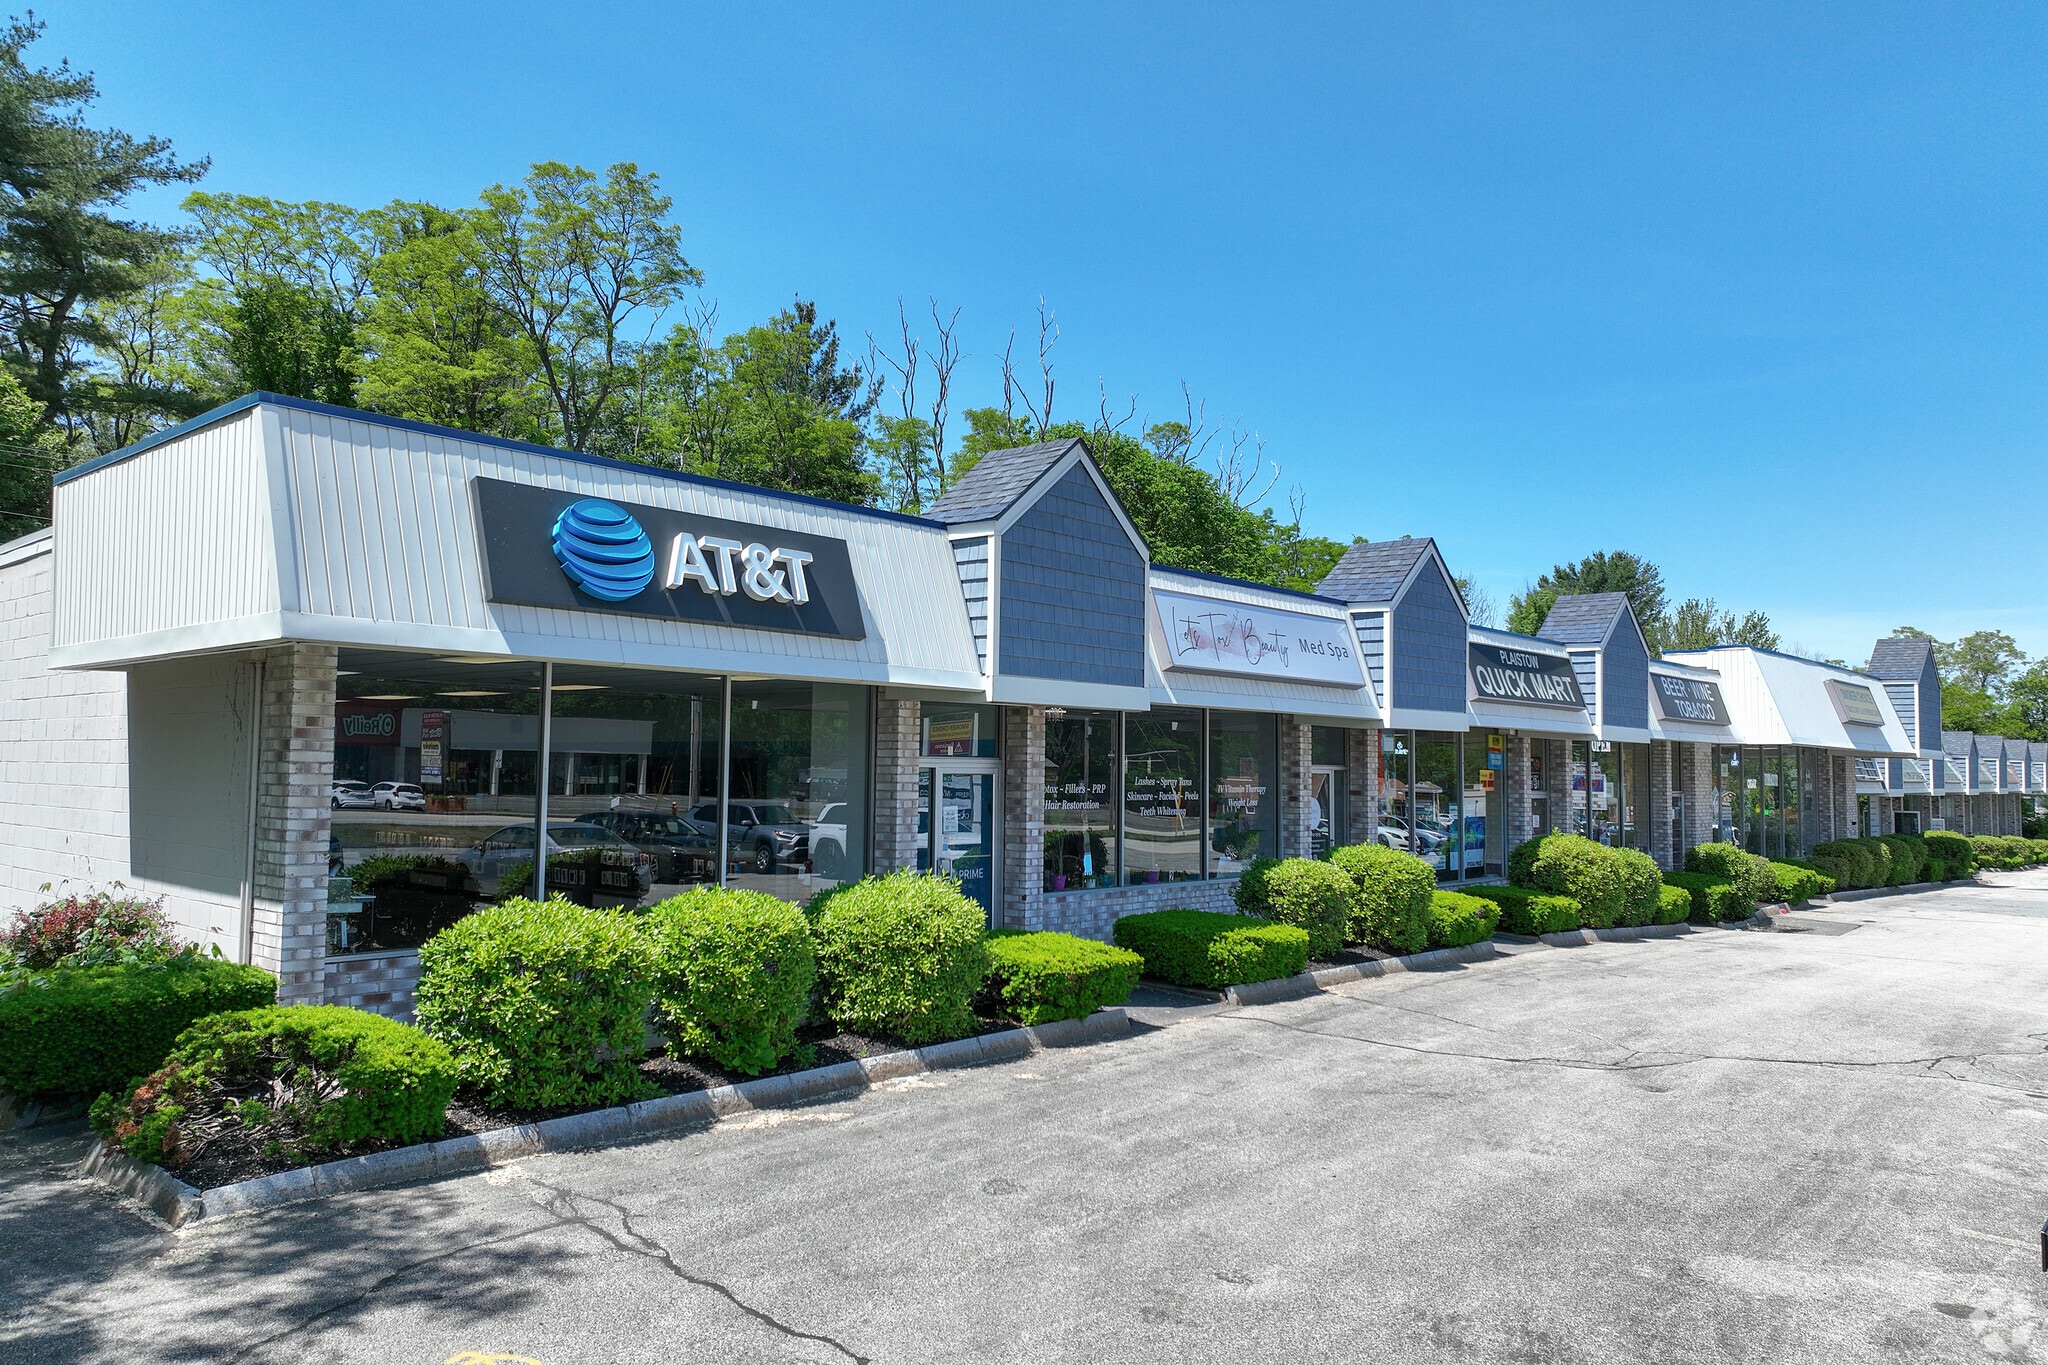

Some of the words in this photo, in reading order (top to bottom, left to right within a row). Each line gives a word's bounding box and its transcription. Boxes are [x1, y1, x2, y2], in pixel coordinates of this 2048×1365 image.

[665, 532, 813, 606] AT&T
[1241, 618, 1289, 668] Beauty
[1298, 638, 1325, 655] Med
[1326, 642, 1349, 661] Spa
[1499, 649, 1540, 669] PLAISTOW
[1475, 664, 1535, 698] QUICK
[1529, 672, 1577, 703] MART
[1660, 676, 1689, 698] BEER
[1689, 681, 1715, 702] WINE
[1674, 699, 1716, 721] TOBACCO
[1043, 784, 1059, 794] otox
[1064, 783, 1086, 794] Fillers
[1091, 783, 1107, 794] PRP
[1134, 776, 1156, 786] Lashes
[1160, 777, 1178, 789] Spray
[1179, 777, 1193, 786] Tans
[1127, 791, 1154, 801] Skincare
[1184, 790, 1199, 800] Peels
[1245, 784, 1267, 795] Therapy
[1044, 799, 1061, 810] Hair
[1062, 799, 1100, 810] Restoration
[1246, 798, 1259, 807] Loss
[1140, 806, 1156, 816] Teeth
[958, 867, 985, 880] PRIME
